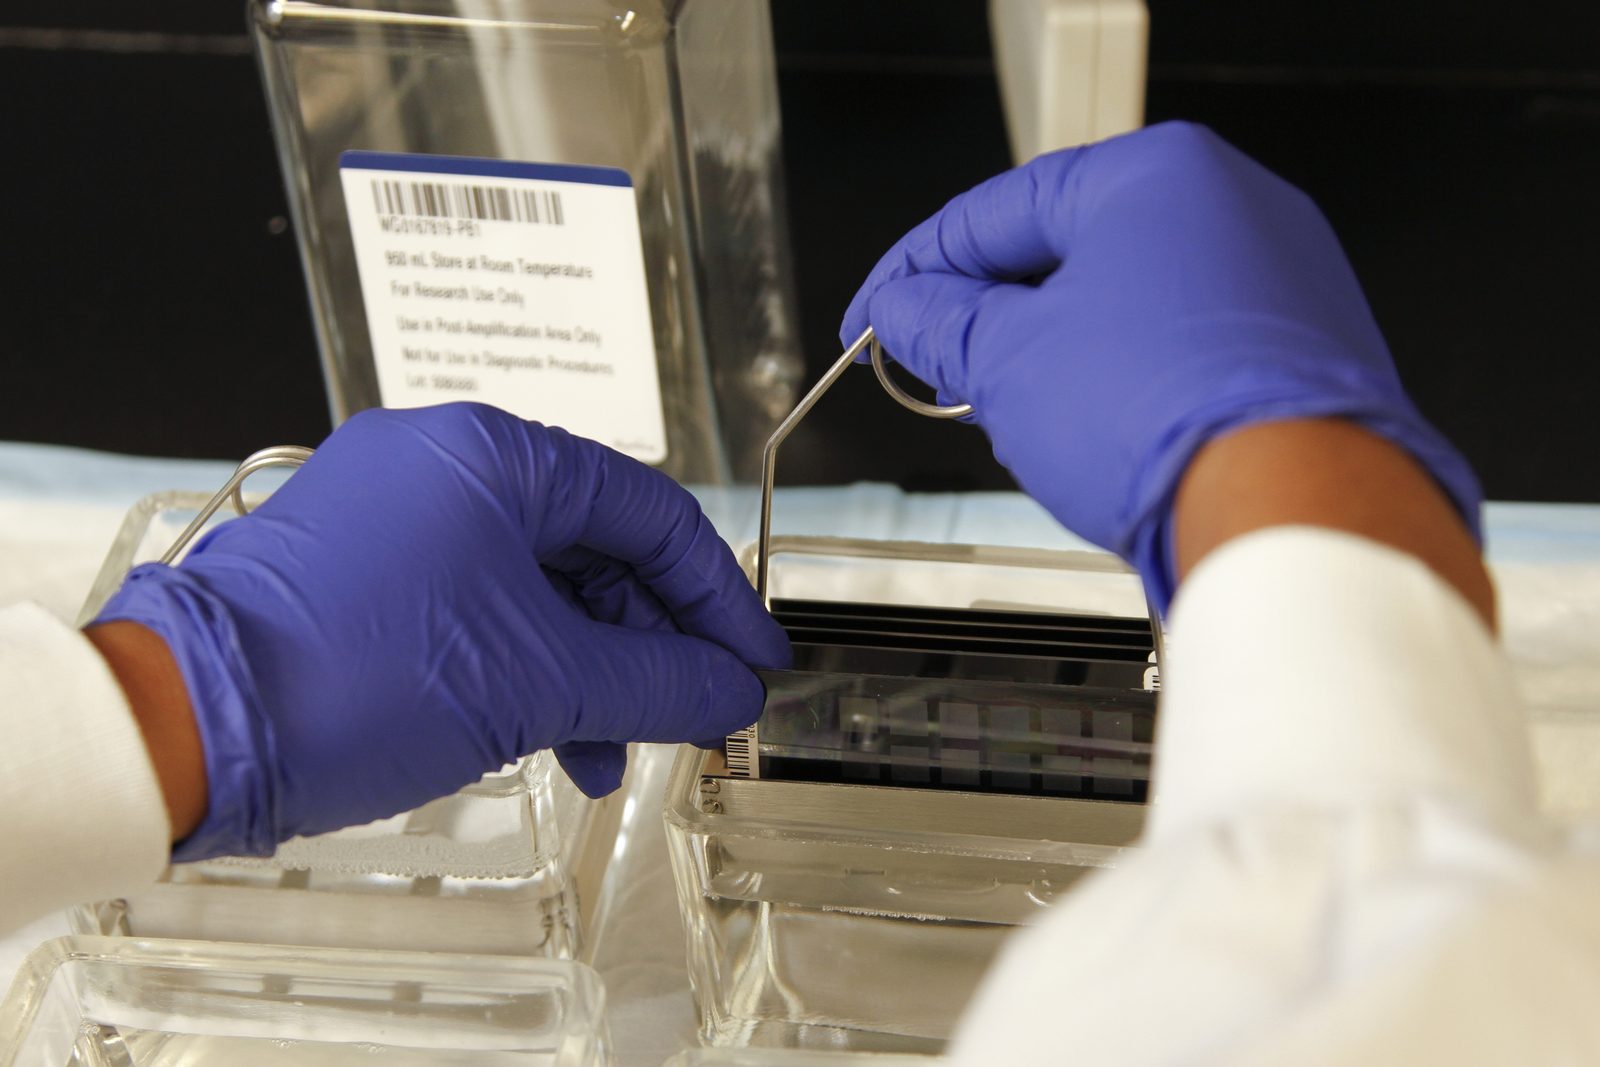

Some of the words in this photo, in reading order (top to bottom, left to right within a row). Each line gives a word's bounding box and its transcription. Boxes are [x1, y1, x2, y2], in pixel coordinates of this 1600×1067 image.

[431, 251, 463, 270] Store
[466, 255, 477, 270] at
[480, 255, 514, 273] Room
[517, 258, 593, 279] Temperature
[391, 280, 410, 296] For
[414, 282, 469, 300] Research
[473, 286, 494, 301] Use
[497, 287, 525, 308] Only
[397, 315, 419, 331] Use
[423, 317, 433, 332] in
[546, 325, 571, 340] Area
[574, 326, 601, 347] Only
[402, 346, 422, 361] Not
[425, 347, 441, 363] for
[446, 350, 466, 364] Use
[470, 353, 480, 365] in
[483, 350, 544, 371] Diagnostic
[548, 355, 614, 375] Procedures
